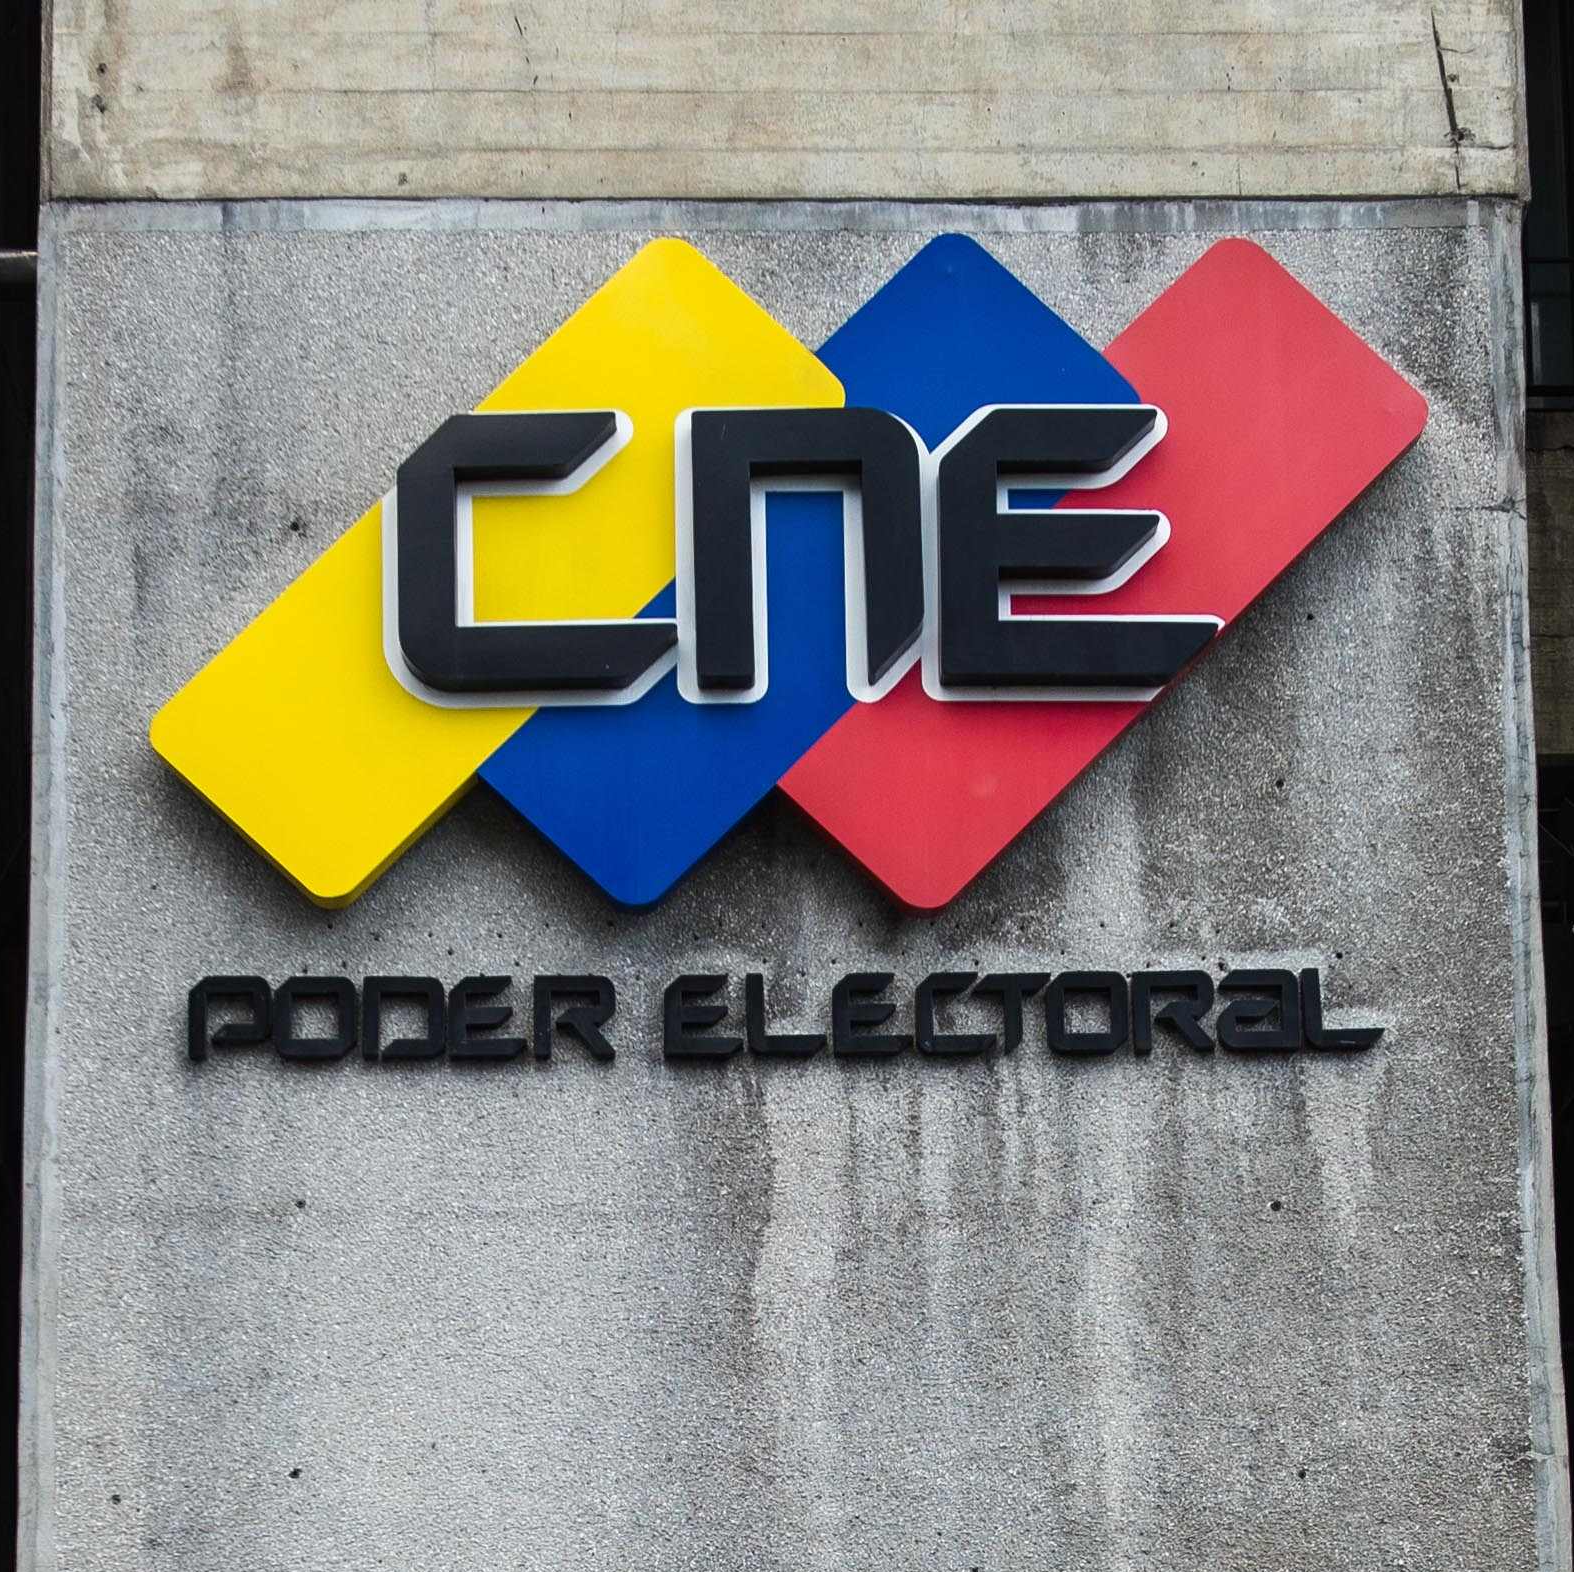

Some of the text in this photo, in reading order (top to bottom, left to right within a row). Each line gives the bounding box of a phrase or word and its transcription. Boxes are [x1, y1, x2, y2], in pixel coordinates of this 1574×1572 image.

[385, 404, 1223, 704] CNE
[188, 967, 1385, 1061] PODER ELECTORAL
